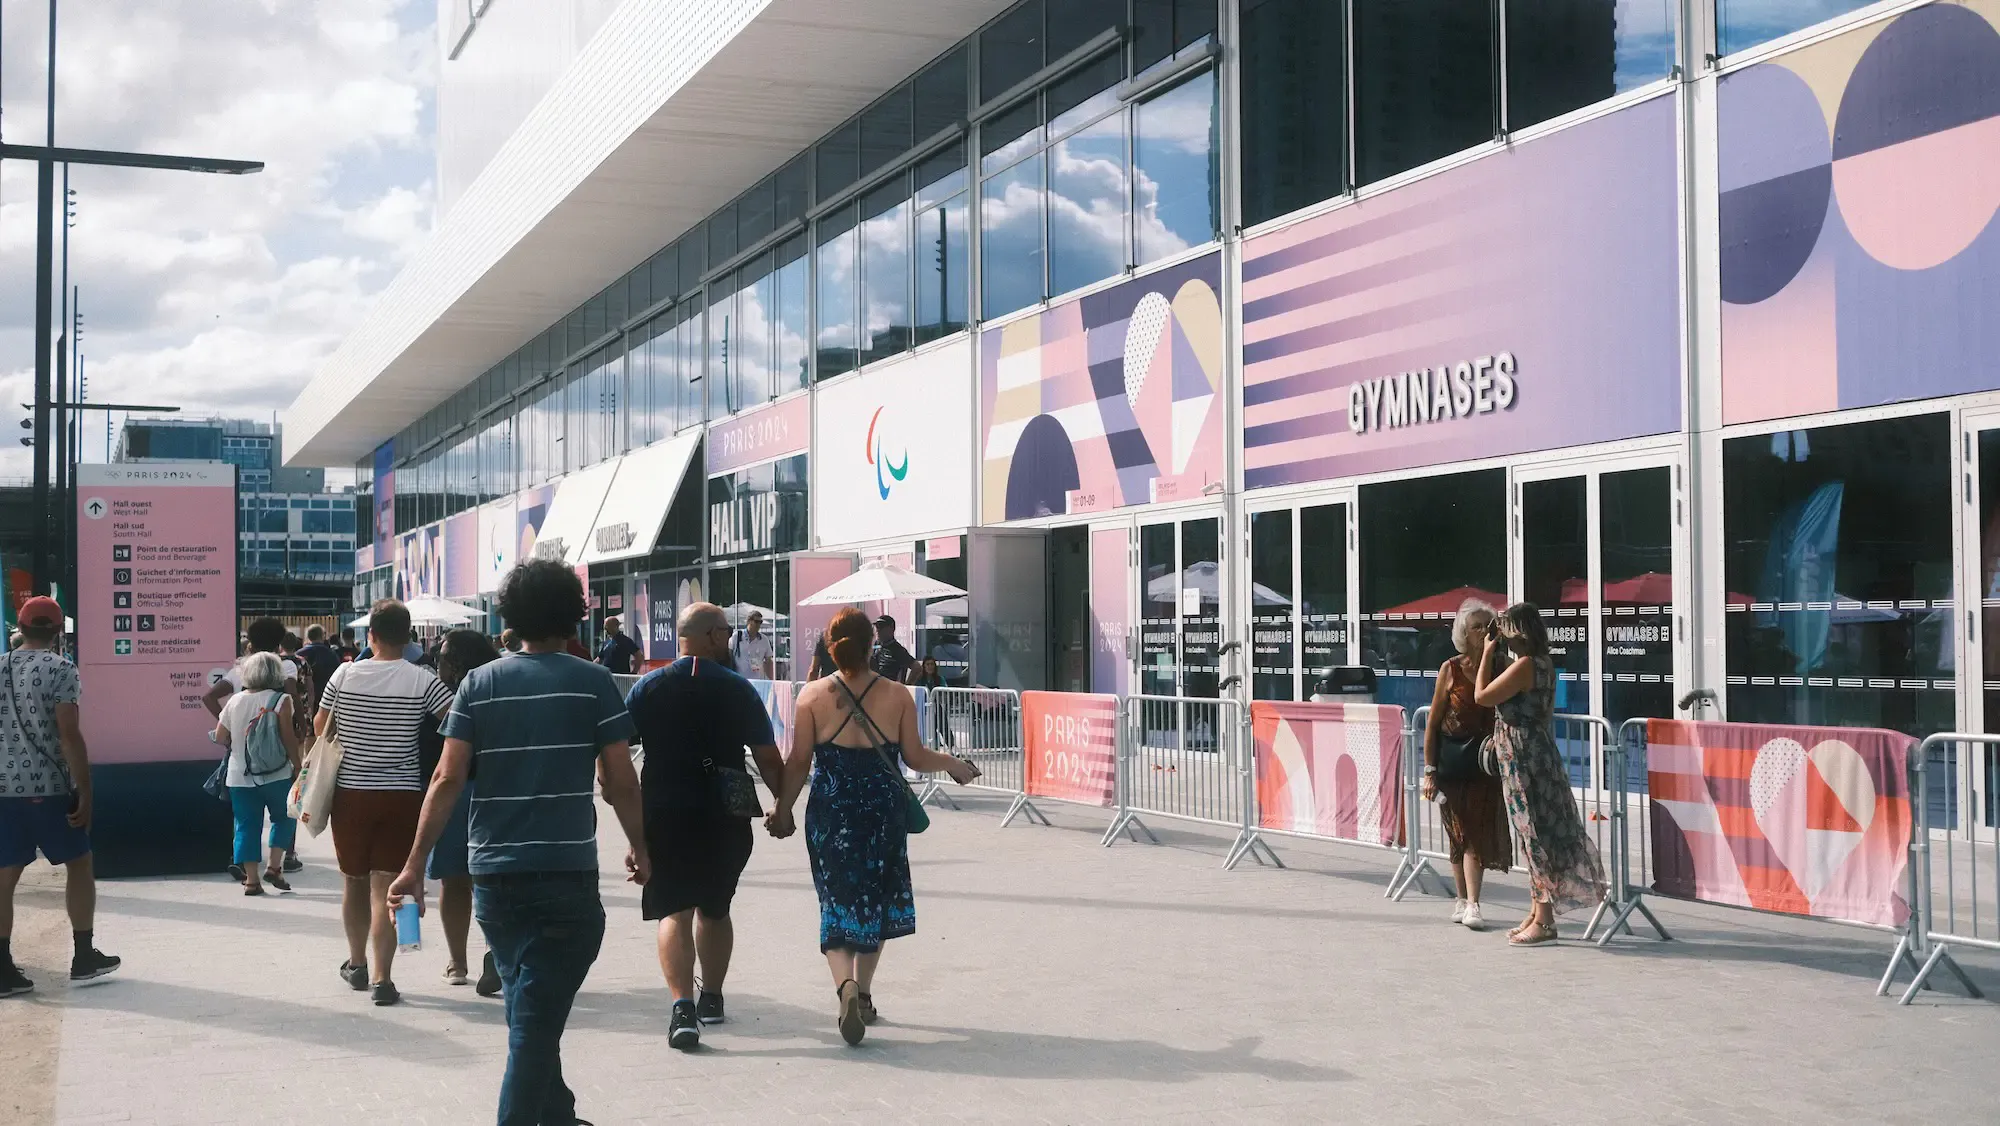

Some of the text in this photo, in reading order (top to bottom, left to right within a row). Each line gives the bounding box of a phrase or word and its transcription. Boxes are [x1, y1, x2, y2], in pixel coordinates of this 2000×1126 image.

[1348, 351, 1516, 433] GYMNASES
[724, 411, 789, 457] PARIS 2024
[711, 491, 778, 556] HALL VIP
[174, 554, 206, 562] Beverage
[165, 600, 184, 608] Shop
[655, 600, 672, 619] PARIS
[655, 622, 672, 642] 2024
[1143, 632, 1170, 644] GYMNASES
[1184, 632, 1212, 644] GYMNASES
[1254, 630, 1286, 643] GYMNASES
[1304, 630, 1339, 643] GYMNASES
[1548, 627, 1576, 642] NASES
[1606, 626, 1659, 642] GYMNASES
[1100, 638, 1122, 652] 2024
[1606, 646, 1646, 655] Alice Coachman
[1044, 749, 1092, 785] 2024
